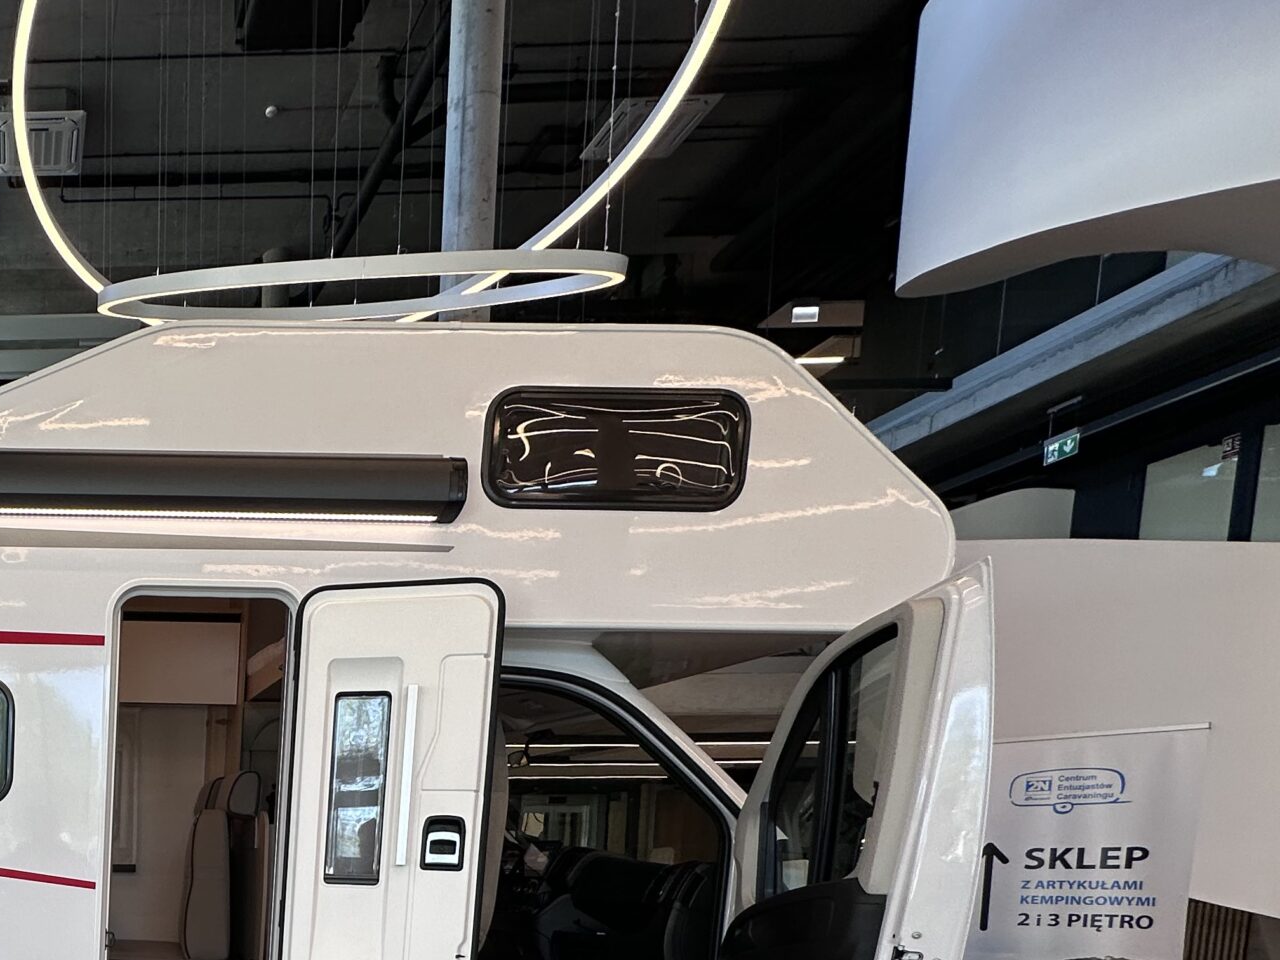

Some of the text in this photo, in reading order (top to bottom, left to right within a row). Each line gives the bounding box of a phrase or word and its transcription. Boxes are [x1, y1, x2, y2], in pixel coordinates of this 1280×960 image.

[1057, 774, 1097, 782] Centrum
[1024, 846, 1150, 870] SKLEP
[1020, 880, 1144, 890] Z ARTYKUŁAMI
[1019, 895, 1157, 907] KEMPINGOWYMI
[1017, 912, 1154, 932] 2 i 3 PIĘTRO
